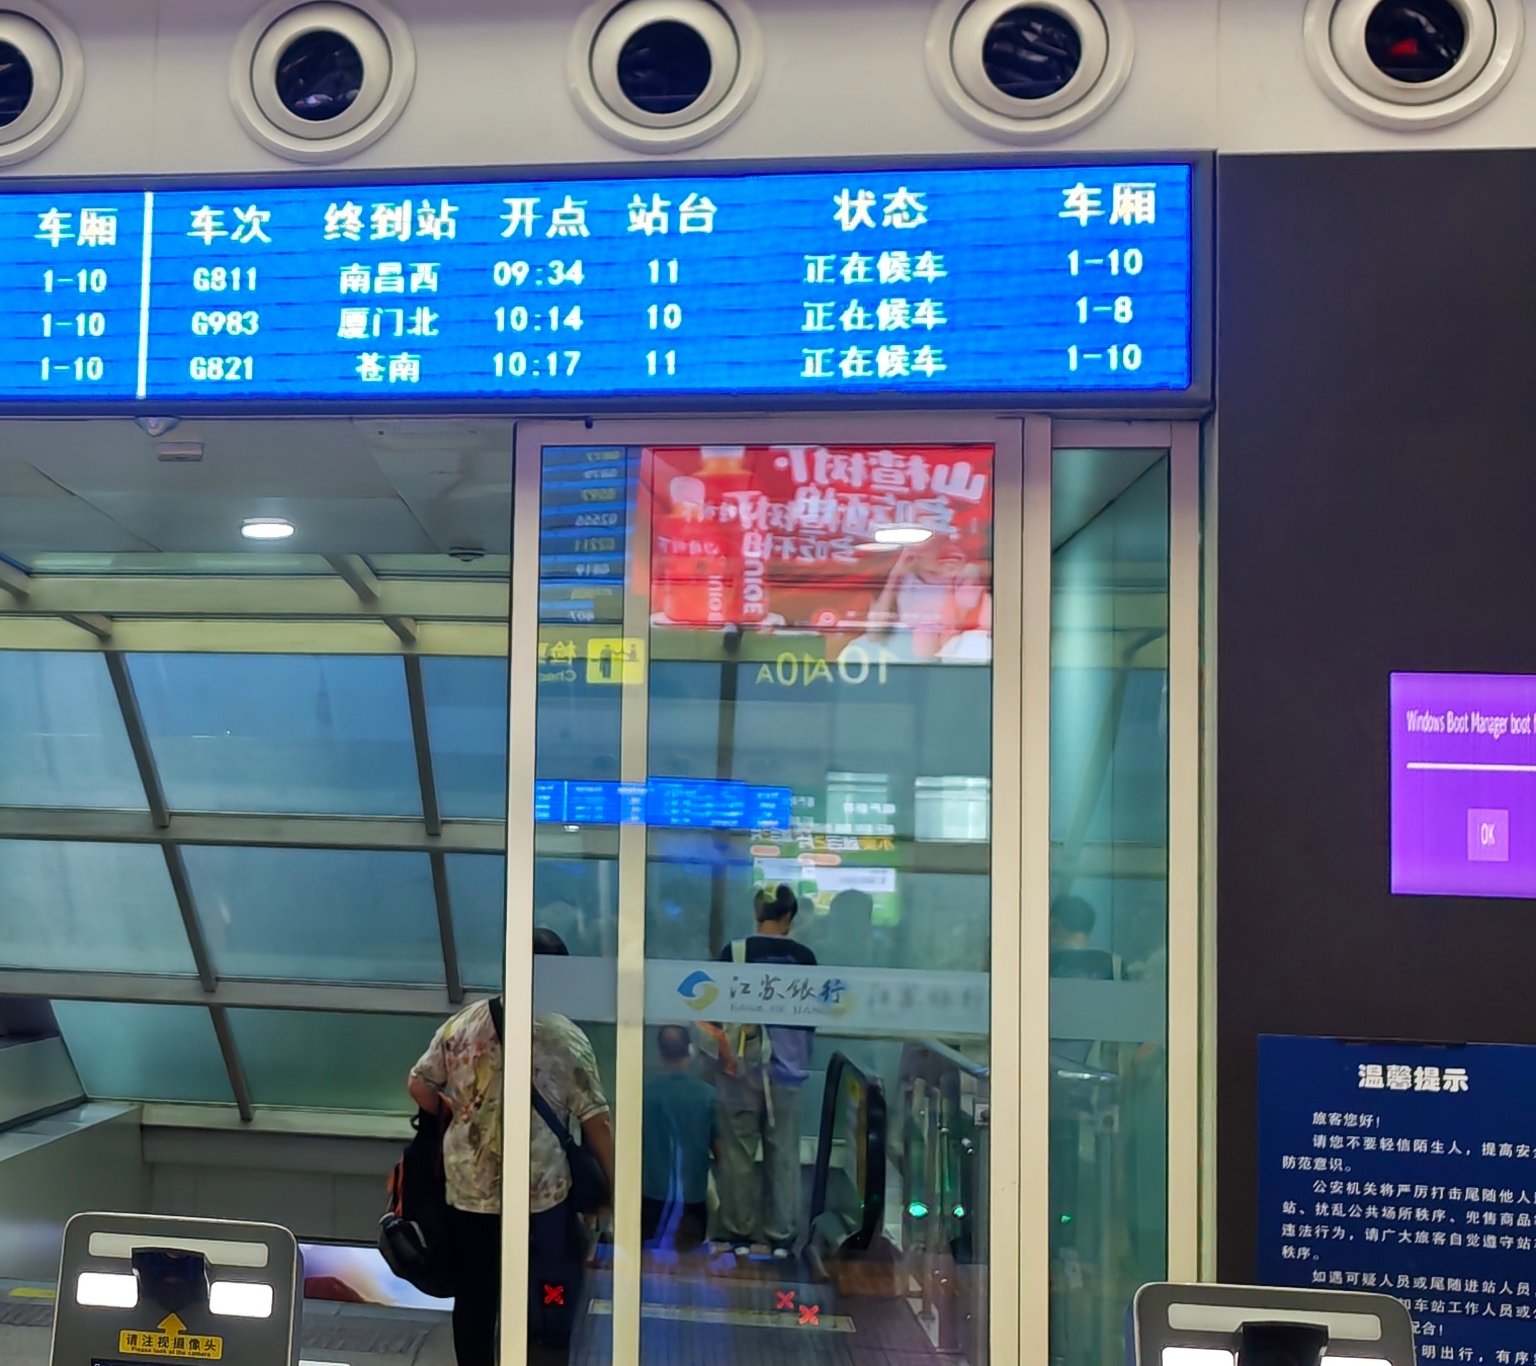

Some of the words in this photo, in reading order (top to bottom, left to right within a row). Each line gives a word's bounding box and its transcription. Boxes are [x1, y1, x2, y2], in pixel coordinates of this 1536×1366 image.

[34, 207, 118, 248] 车厢
[186, 204, 272, 245] 车次
[323, 198, 459, 242] 终到站
[500, 196, 590, 239] 开点
[627, 193, 718, 235] 站台
[833, 186, 928, 231] 状态
[1059, 182, 1157, 226] 车厢
[43, 268, 107, 293] 1-10
[192, 267, 257, 292] G811
[339, 262, 441, 295] 南昌西
[493, 260, 584, 287] 09:34
[648, 258, 679, 284] 11
[803, 251, 948, 285] 正在候车
[1067, 248, 1143, 276] 1-10
[41, 312, 106, 337] 1-10
[192, 311, 259, 336] G983
[337, 306, 440, 340] 厦门北
[494, 305, 583, 332] 10:14
[646, 303, 682, 330] 10
[801, 298, 947, 332] 正在候车
[1075, 296, 1134, 324] 1-8
[40, 356, 104, 380] 1-10
[190, 357, 254, 381] G821
[355, 352, 421, 384] 苍南
[493, 351, 581, 378] 10:17
[645, 350, 676, 376] 11
[800, 344, 947, 378] 正在候车
[1067, 343, 1143, 371] 1-10
[1406, 710, 1445, 733] Windows
[1447, 711, 1469, 734] Boot
[1471, 711, 1509, 740] Manager
[1510, 712, 1531, 735] boot
[1480, 822, 1496, 845] OK
[729, 974, 846, 1004] 江苏银行
[1358, 1063, 1469, 1093] 温馨提示
[1312, 1133, 1536, 1160] 请您不要轻信陌生人，提高安
[1312, 1179, 1536, 1206] 公安机关将严厉打击尾随他人
[1282, 1200, 1536, 1228] 站、扰乱公共场所秩序、兜售商品
[1282, 1223, 1536, 1251] 违法行为，请广大旅客自觉遵守站
[126, 1333, 216, 1352] 请注视摄像头
